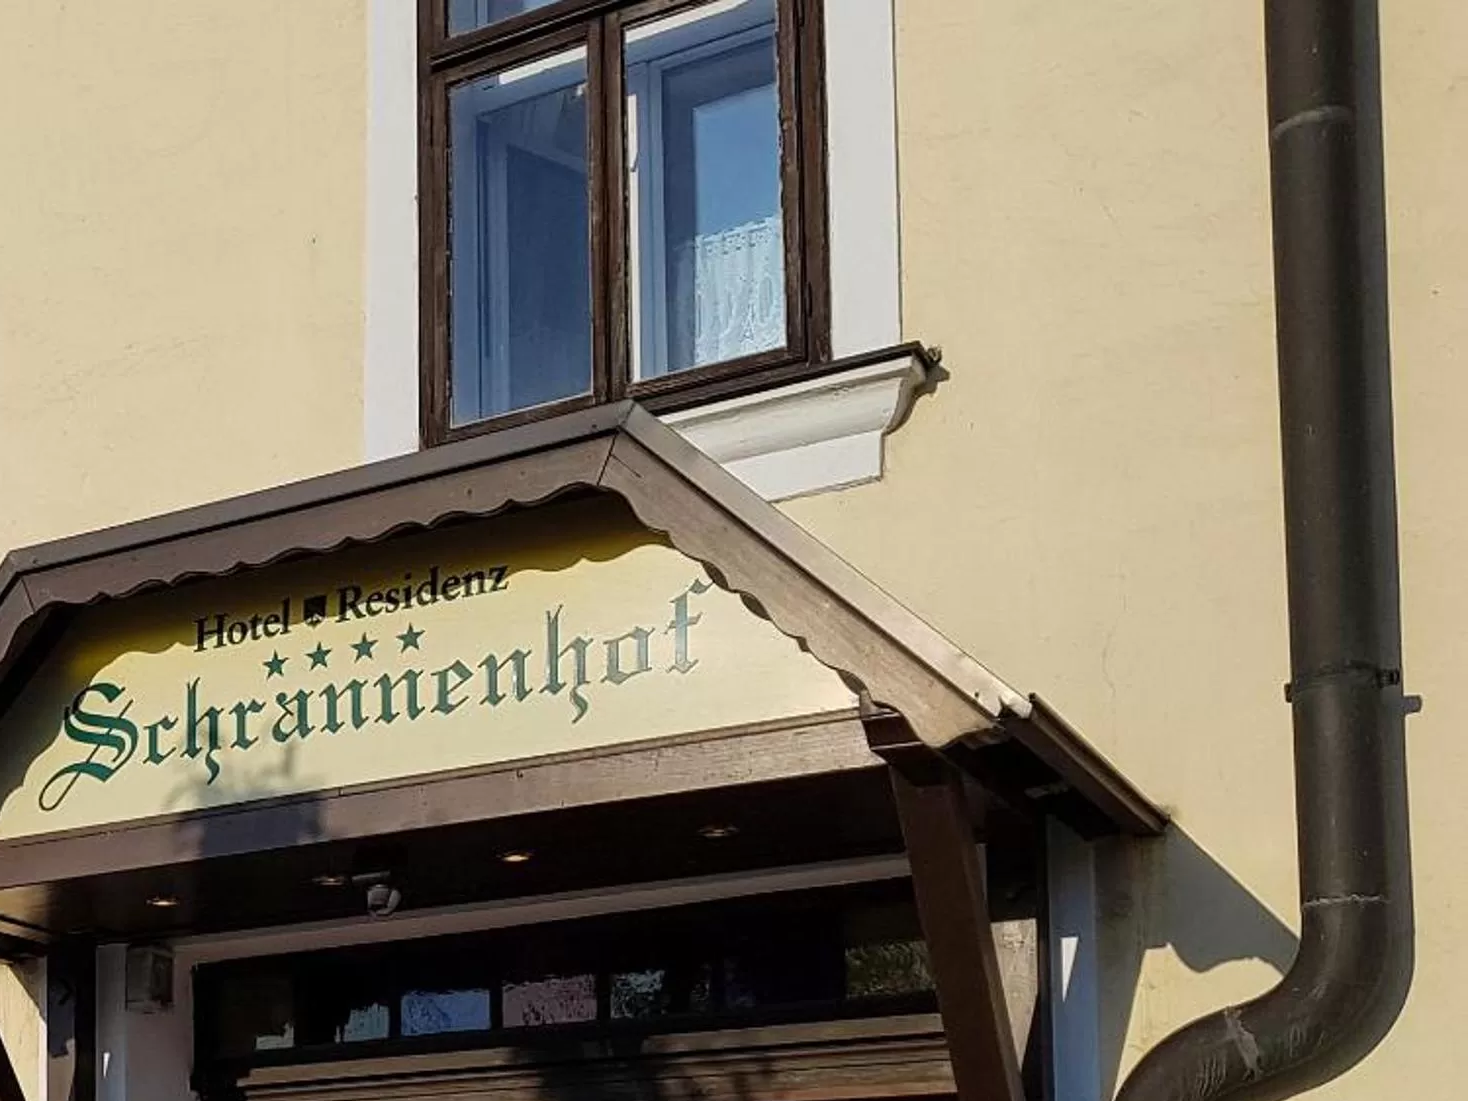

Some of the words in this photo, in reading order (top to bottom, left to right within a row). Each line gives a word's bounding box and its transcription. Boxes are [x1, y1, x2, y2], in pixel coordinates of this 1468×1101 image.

[192, 605, 292, 653] Hotel
[335, 562, 511, 622] Residenz
[38, 577, 716, 812] Schrannenhof
